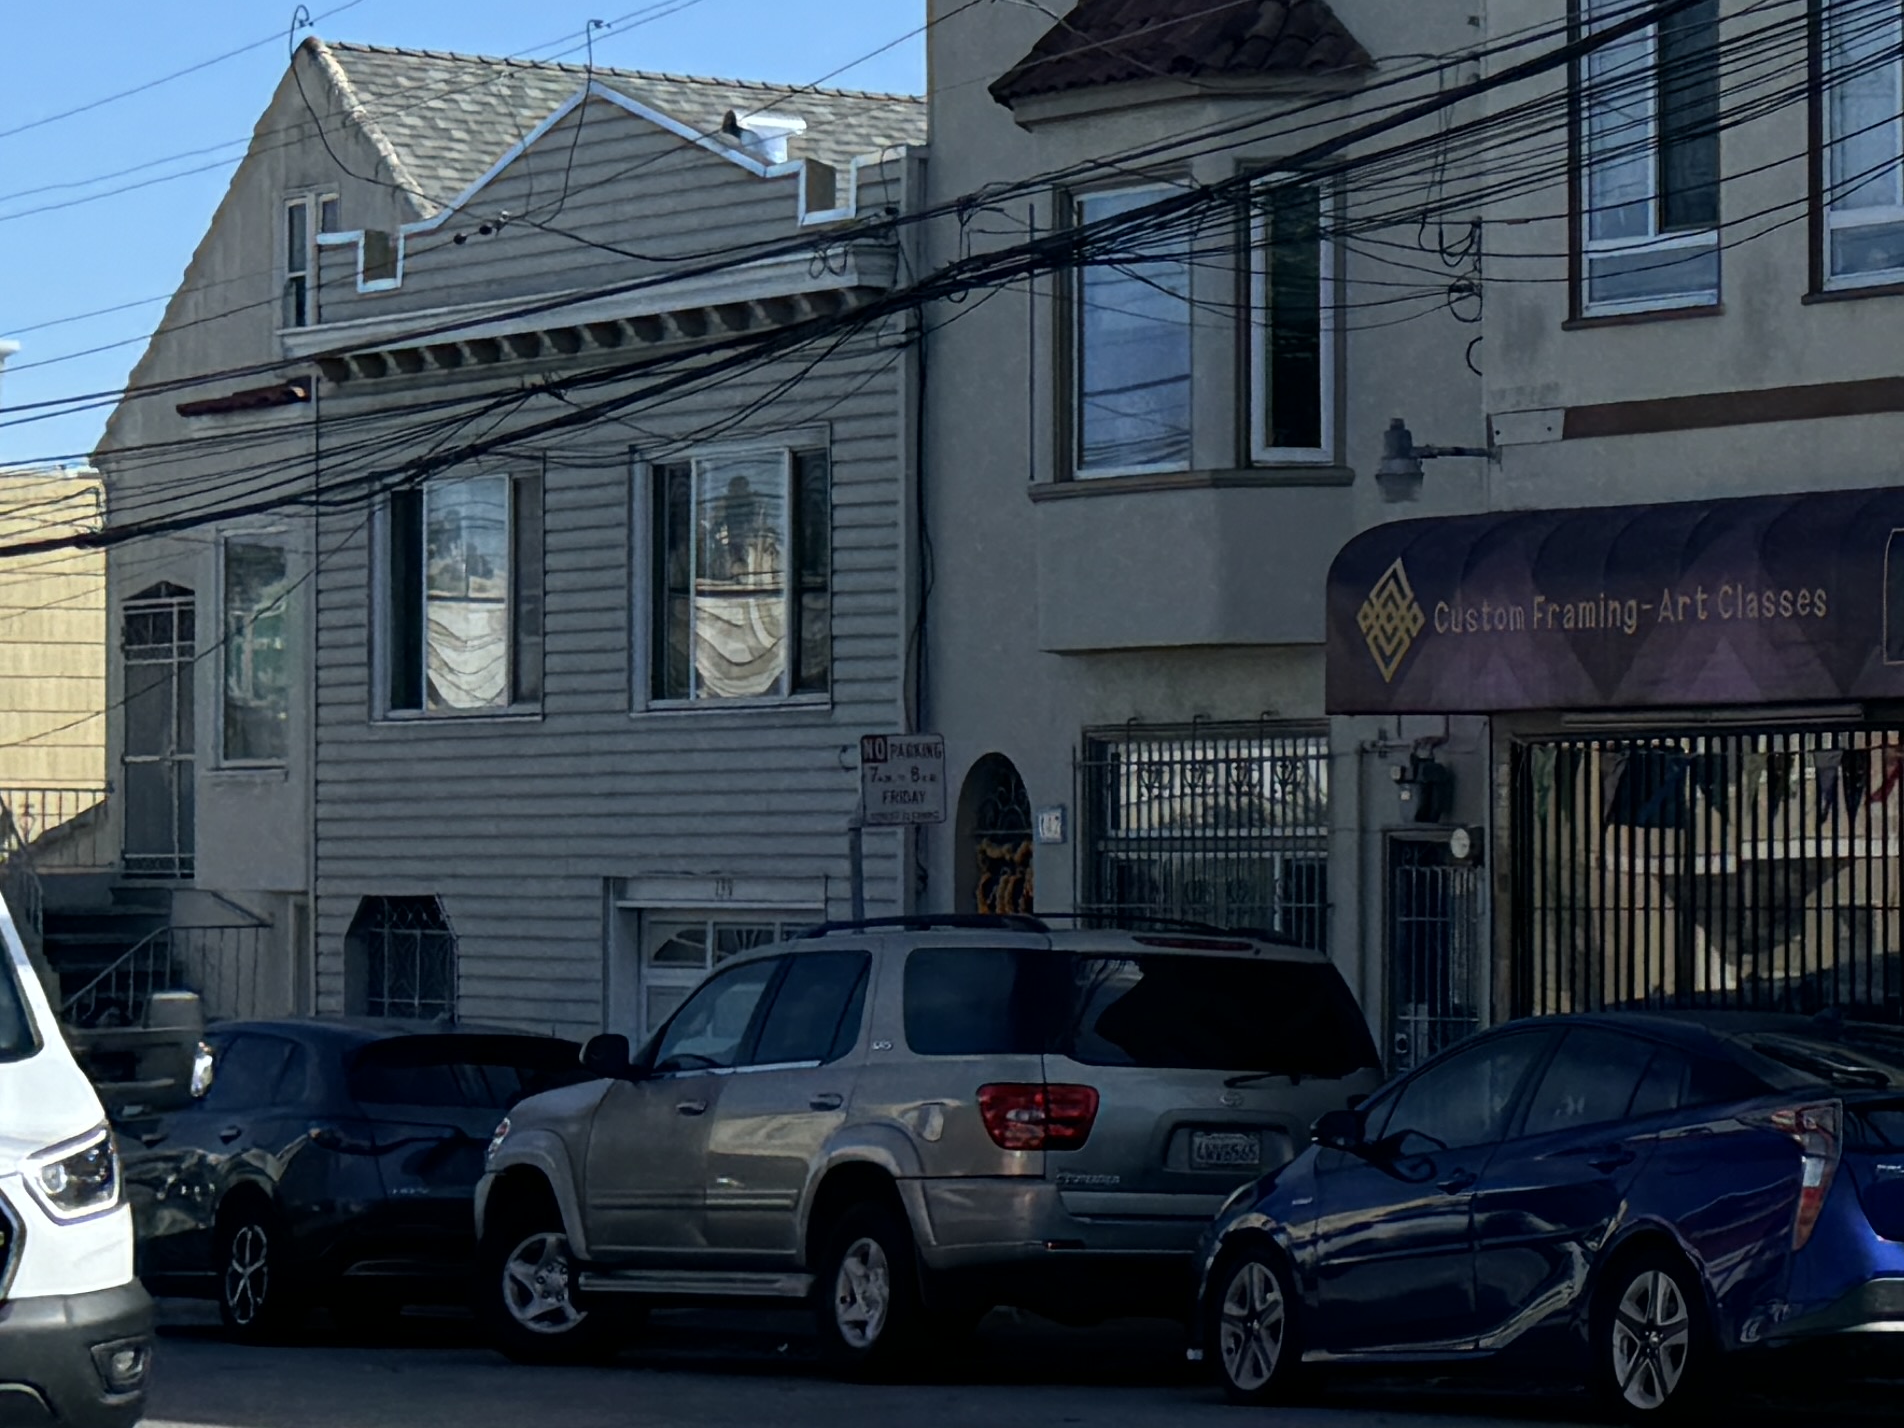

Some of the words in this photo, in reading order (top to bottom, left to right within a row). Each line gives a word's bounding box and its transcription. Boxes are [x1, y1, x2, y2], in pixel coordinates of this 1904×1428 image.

[1434, 600, 1525, 635] Custom
[1717, 582, 1828, 620] Classes
[863, 737, 886, 761] NO
[889, 742, 942, 760] PARKING
[882, 789, 927, 805] FRIDAY
